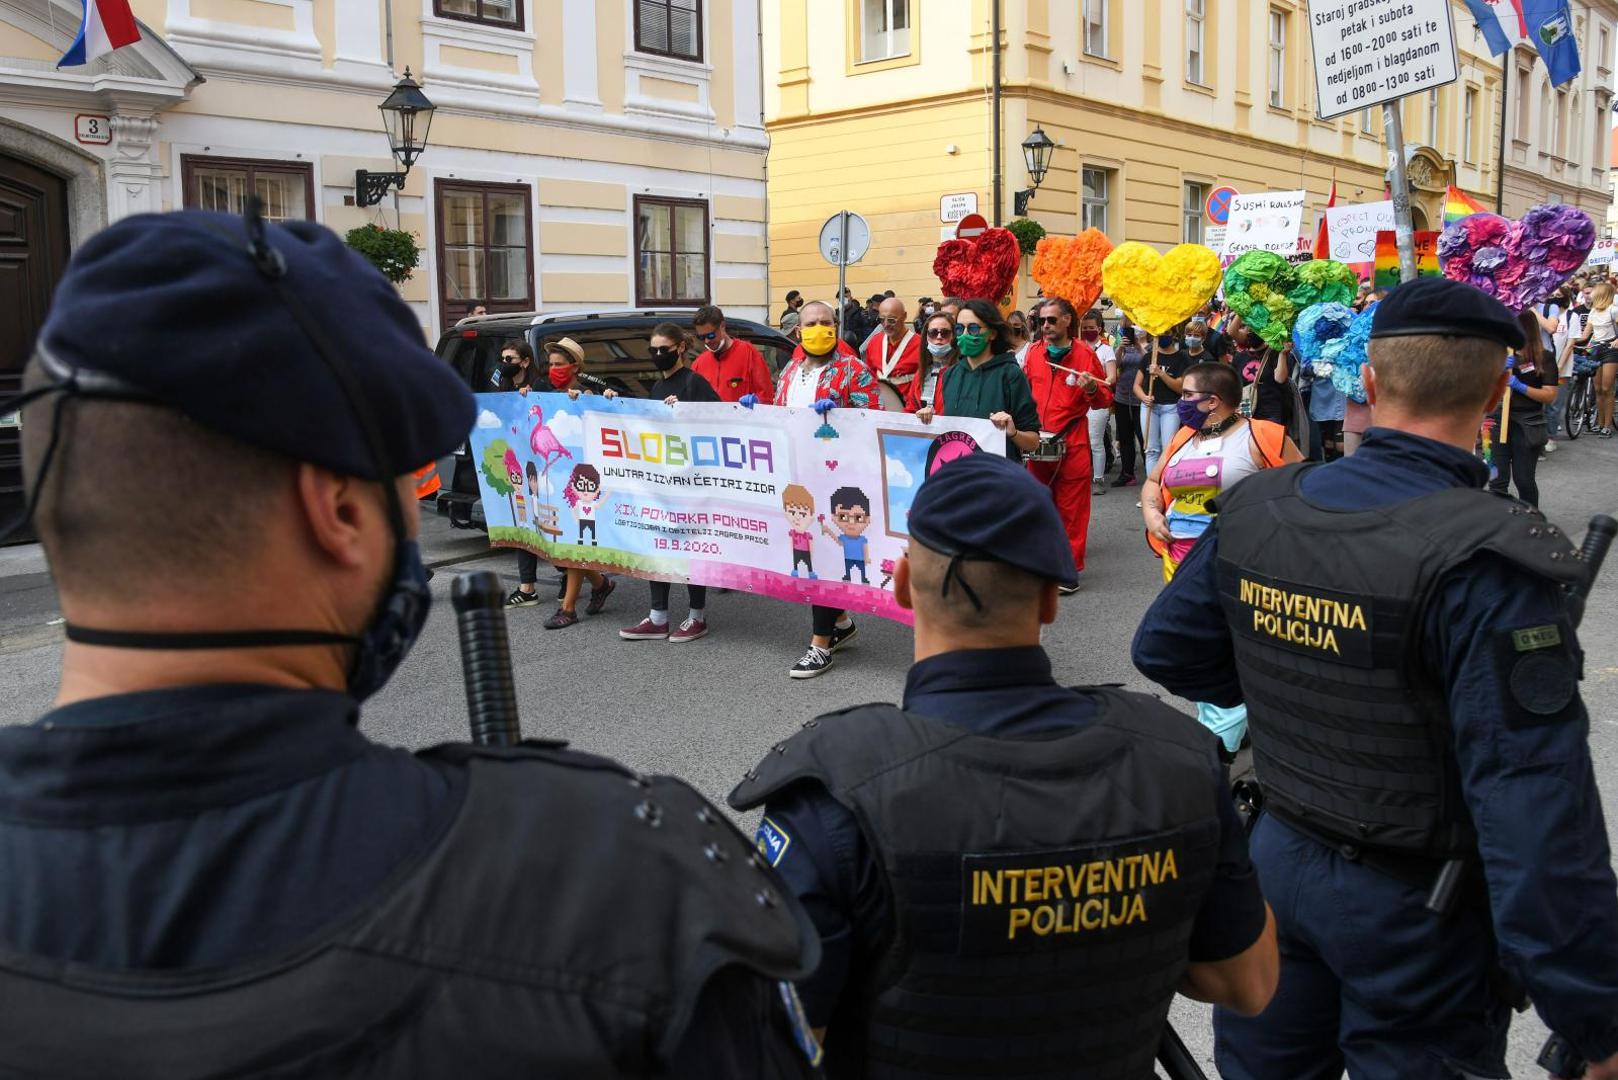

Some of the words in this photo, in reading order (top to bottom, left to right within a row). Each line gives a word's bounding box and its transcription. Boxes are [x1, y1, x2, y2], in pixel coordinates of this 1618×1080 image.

[1315, 4, 1345, 26] Staroj
[1348, 0, 1391, 17] grads
[1341, 19, 1367, 41] petak
[1371, 15, 1375, 27] i
[1378, 4, 1414, 25] subota
[1325, 53, 1336, 66] od
[1402, 25, 1422, 41] sati
[1426, 21, 1437, 33] te
[1327, 63, 1373, 85] nedjeljom
[1377, 59, 1381, 70] i
[1384, 41, 1440, 68] blagdanom
[1336, 91, 1347, 105] od
[1415, 65, 1435, 82] sati
[89, 119, 99, 134] 3
[1376, 212, 1394, 224] OU
[600, 427, 774, 474] SLOBODA
[937, 431, 977, 450] ZAGREB
[603, 466, 645, 481] UNUTAR
[653, 473, 691, 486] IZVAN
[694, 473, 742, 490] ČETIRI
[745, 481, 776, 495] ZIDA
[614, 503, 638, 517] XIX.
[640, 507, 709, 524] POVORKA
[712, 513, 768, 533] PONOSA
[653, 537, 723, 555] 19.9.2020.
[714, 529, 743, 540] ZAGREB
[744, 534, 769, 545] PRIDE
[1240, 578, 1367, 631] INTERVENTNA
[1254, 610, 1340, 656] POLICIJA
[972, 848, 1178, 905] INTERVENTNA
[1008, 894, 1148, 940] POLICIJA
